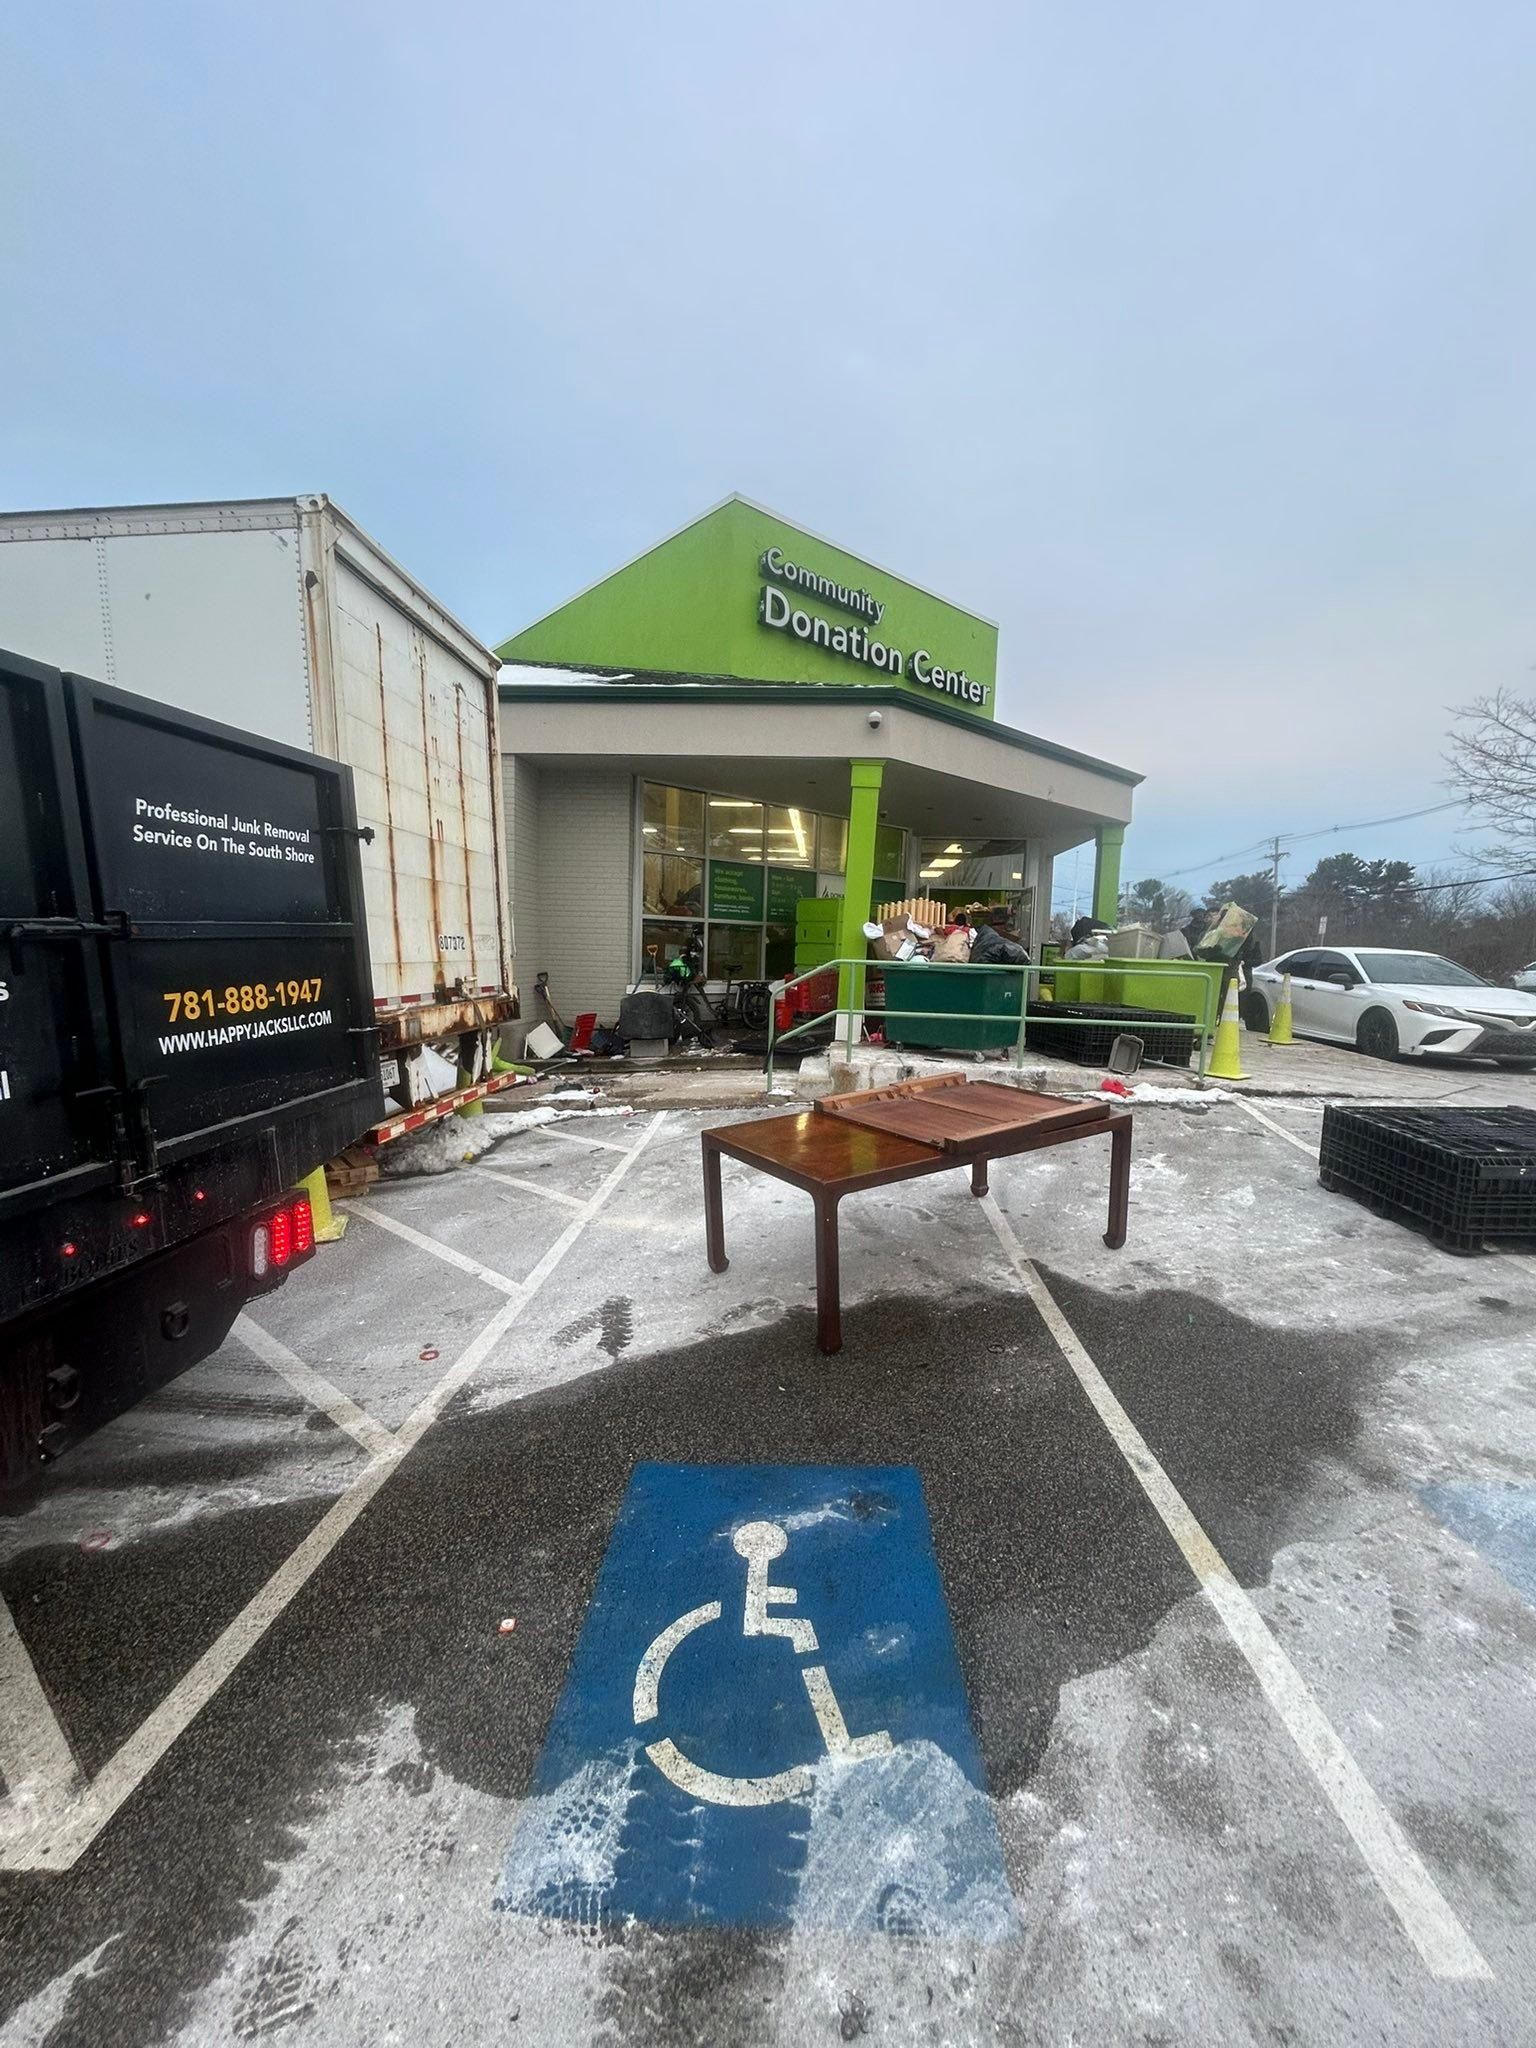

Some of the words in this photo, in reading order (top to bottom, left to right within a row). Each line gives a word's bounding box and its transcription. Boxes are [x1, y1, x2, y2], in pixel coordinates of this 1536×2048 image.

[765, 547, 886, 624] Community
[764, 585, 904, 674] Donation
[912, 649, 991, 706] Center
[135, 798, 228, 831] Professional
[231, 815, 261, 836] Junk
[263, 822, 310, 844] Removal
[133, 824, 192, 849] Service
[196, 834, 218, 852] On
[221, 837, 246, 855] The
[248, 841, 282, 861] South
[284, 846, 315, 865] Shore
[163, 978, 323, 1023] 781-888-1947
[158, 1009, 333, 1055] WWW.HAPPYJACKSLLC.COM
